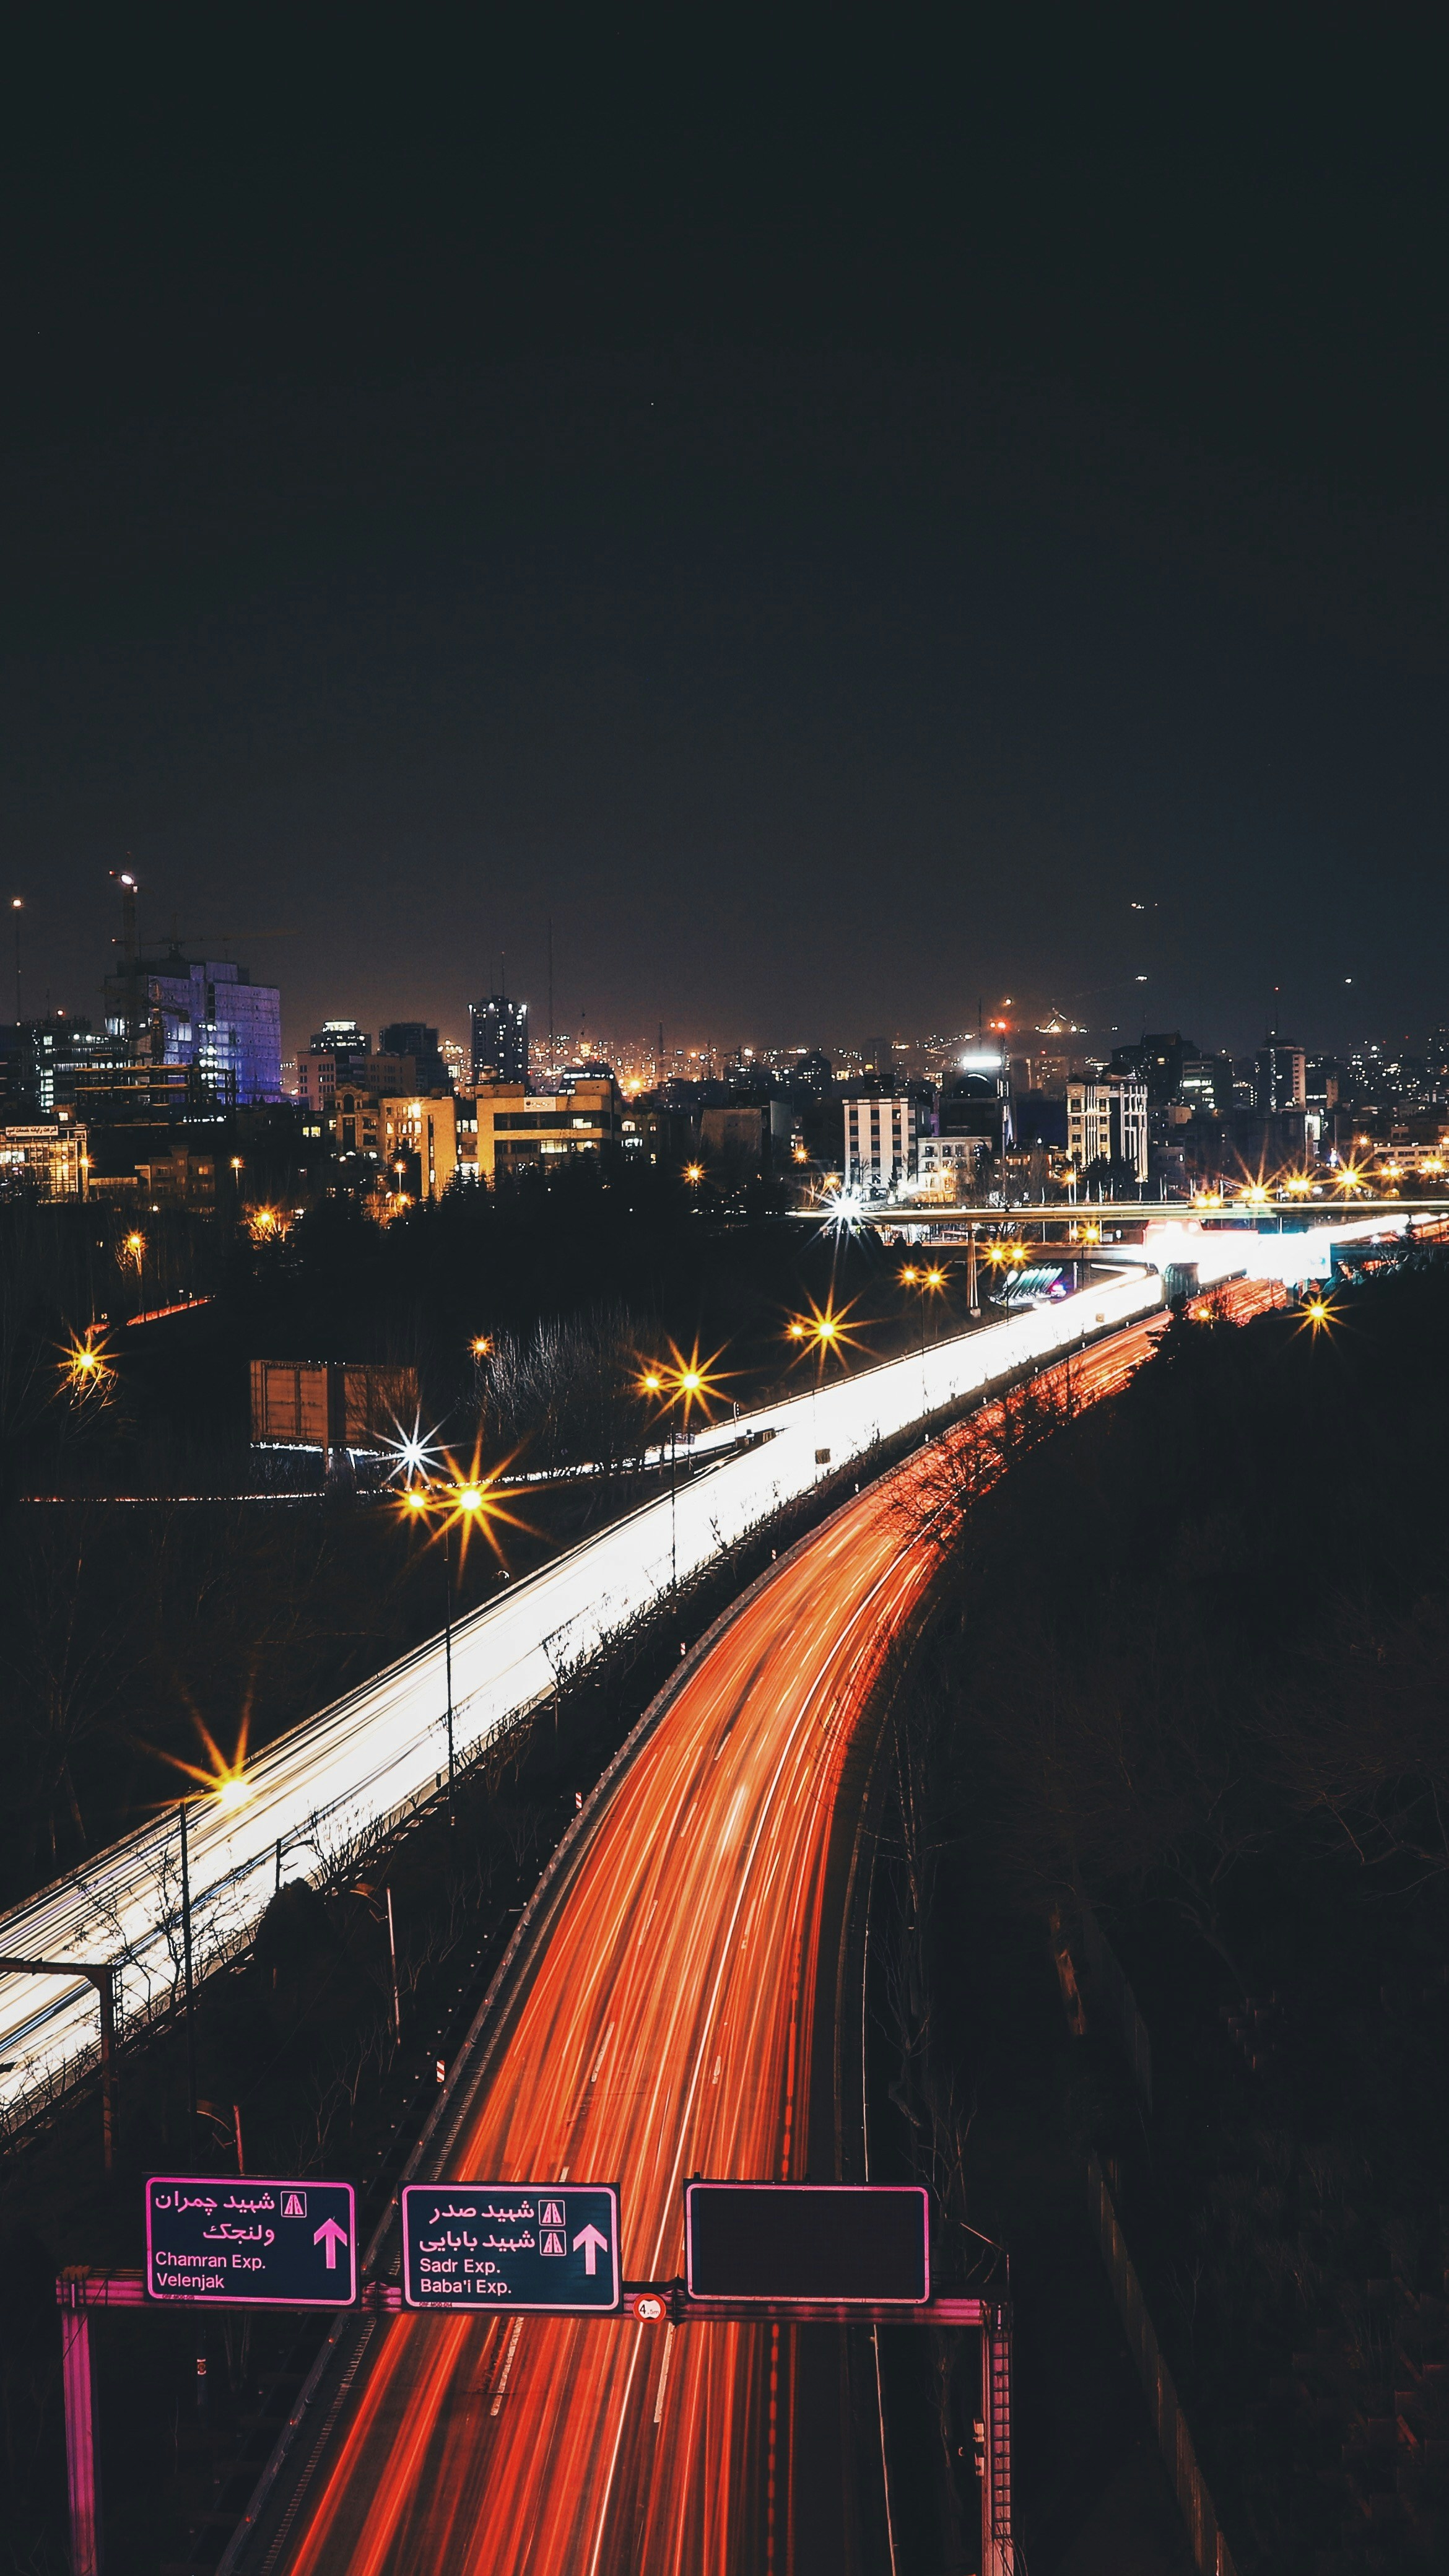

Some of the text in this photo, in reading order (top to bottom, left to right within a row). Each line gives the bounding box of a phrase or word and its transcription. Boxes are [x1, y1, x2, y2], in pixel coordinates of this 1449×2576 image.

[155, 2190, 275, 2216] شهید چمران
[429, 2200, 534, 2224] شهید صدر
[202, 2223, 275, 2247] ولنجک
[419, 2230, 536, 2252] شهید بابایی
[155, 2251, 266, 2271] Chamran Exp.
[420, 2258, 500, 2276] Sadr Exp.
[157, 2273, 225, 2291] Velenjak
[420, 2278, 511, 2297] Baba'i Exp.
